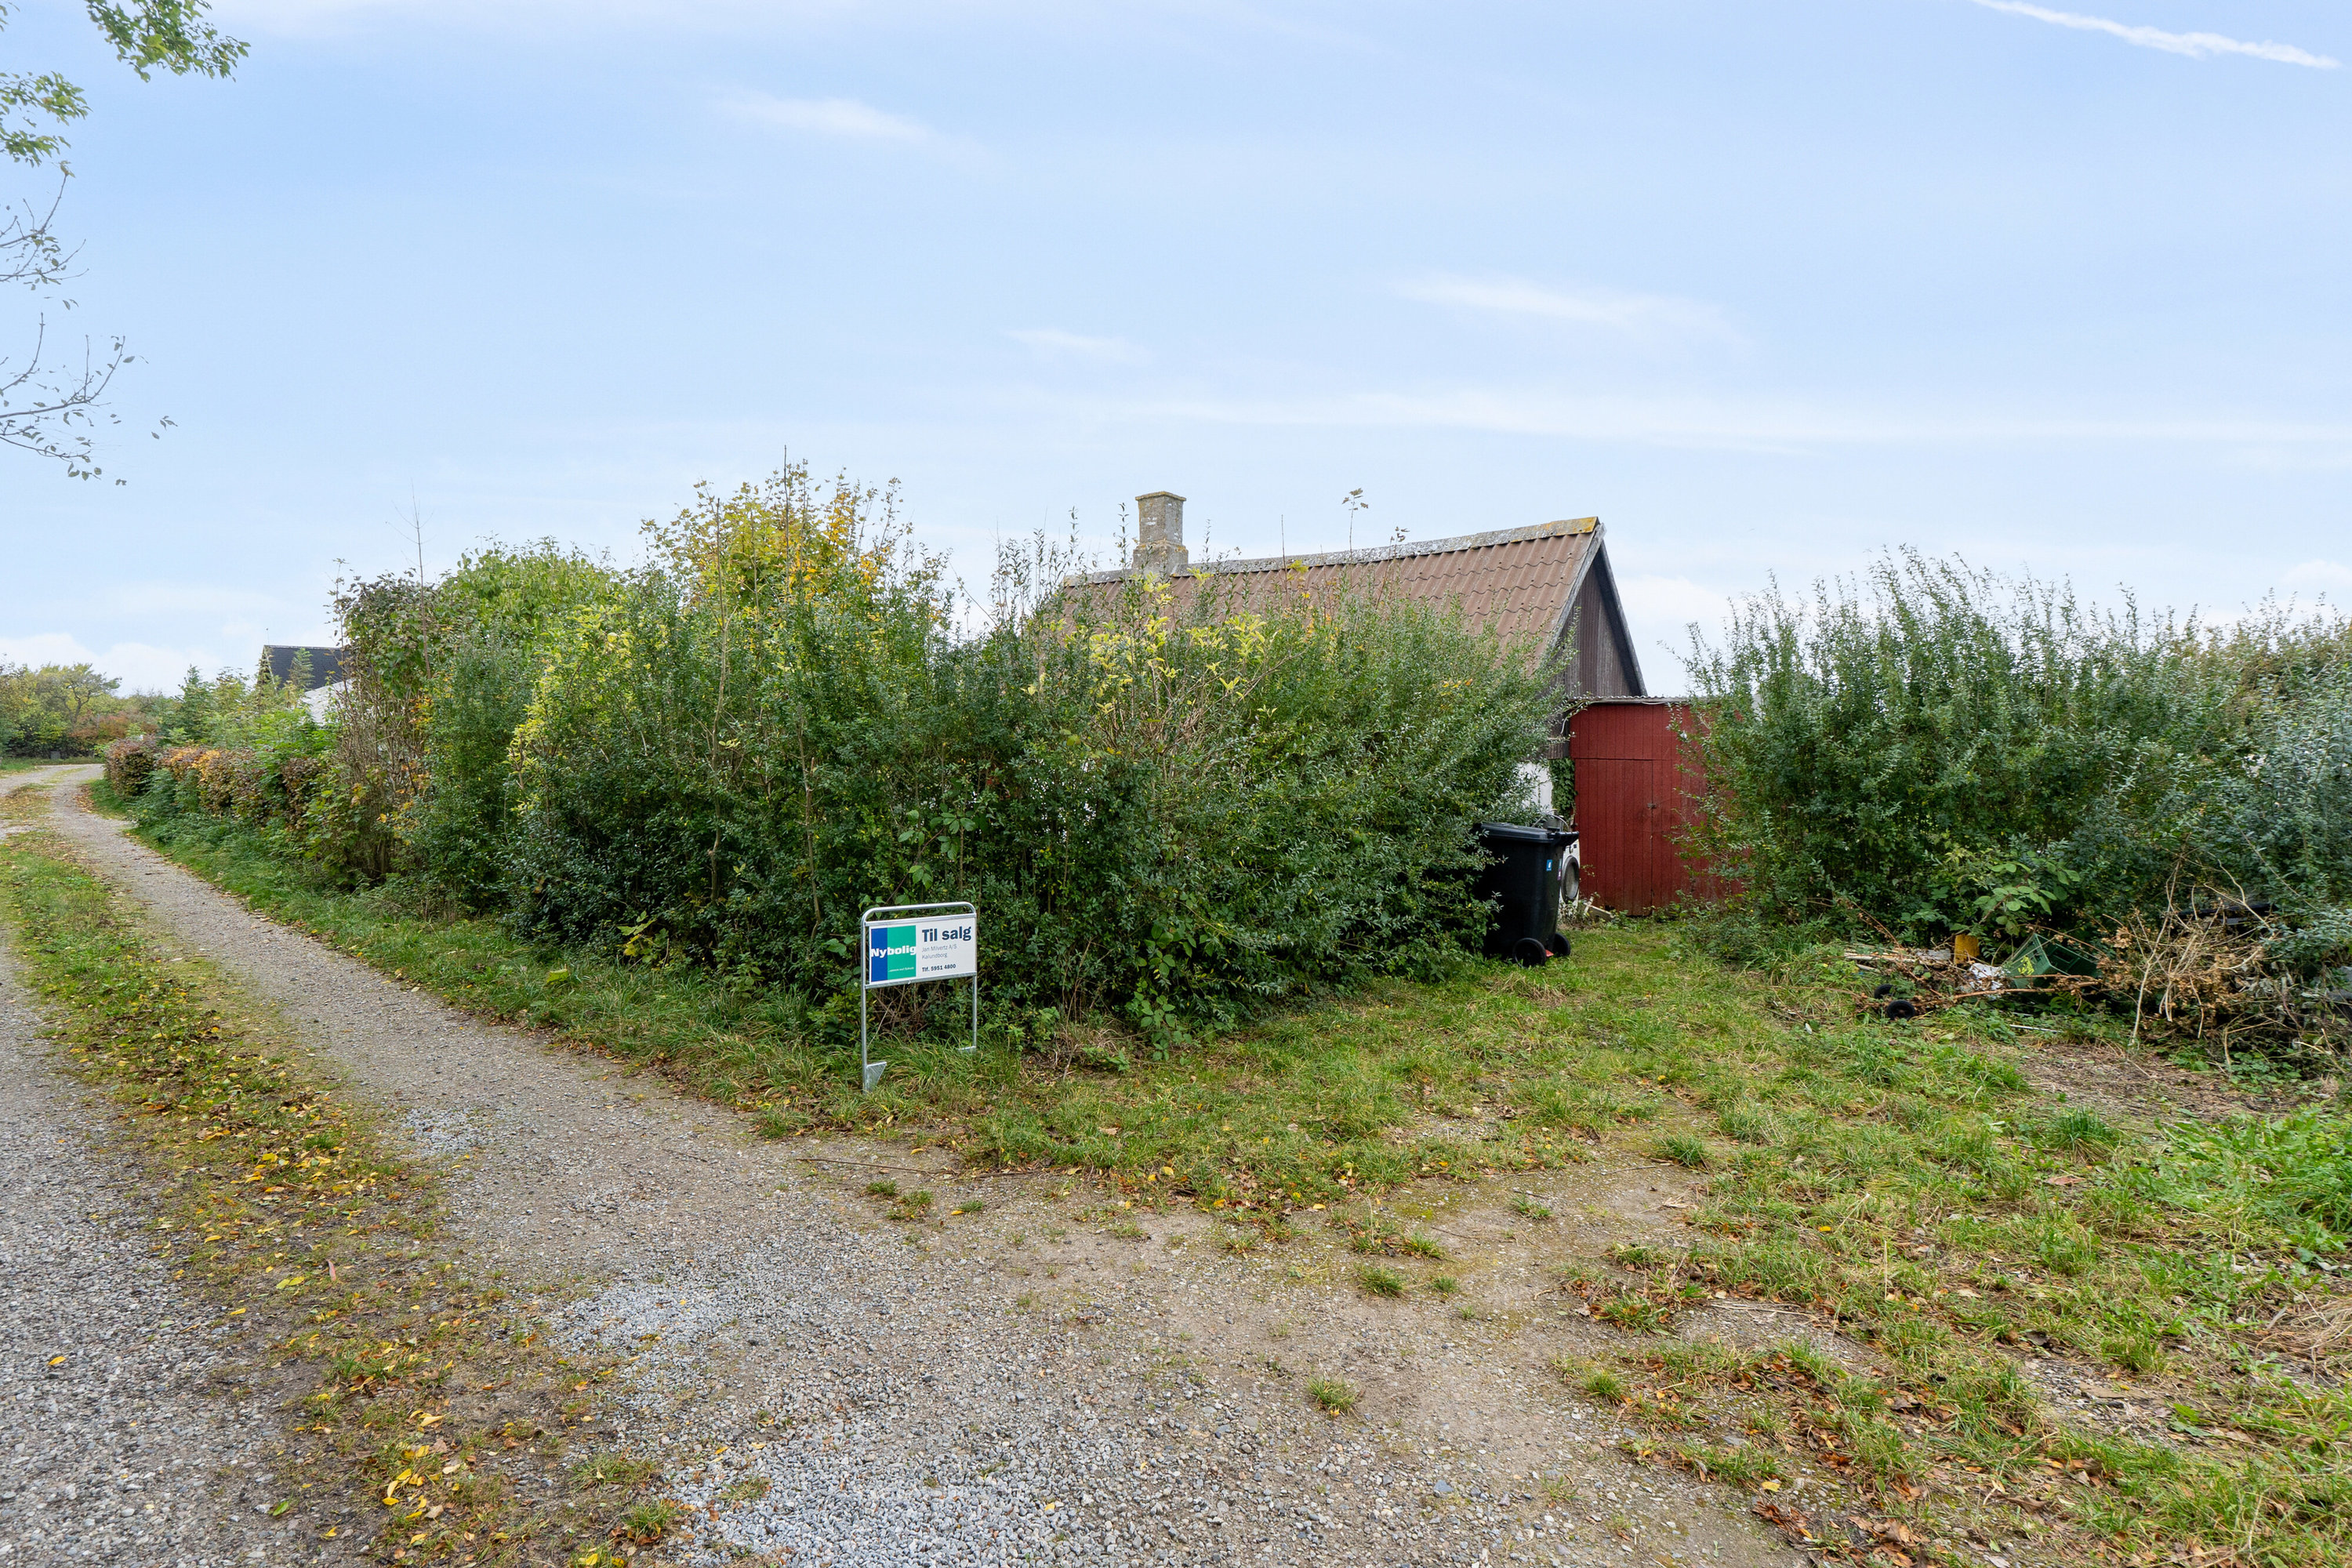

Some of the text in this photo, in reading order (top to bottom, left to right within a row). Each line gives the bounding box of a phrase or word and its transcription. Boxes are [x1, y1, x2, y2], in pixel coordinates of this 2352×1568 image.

[922, 926, 971, 942] Til salg
[870, 945, 916, 958] Nybolig
